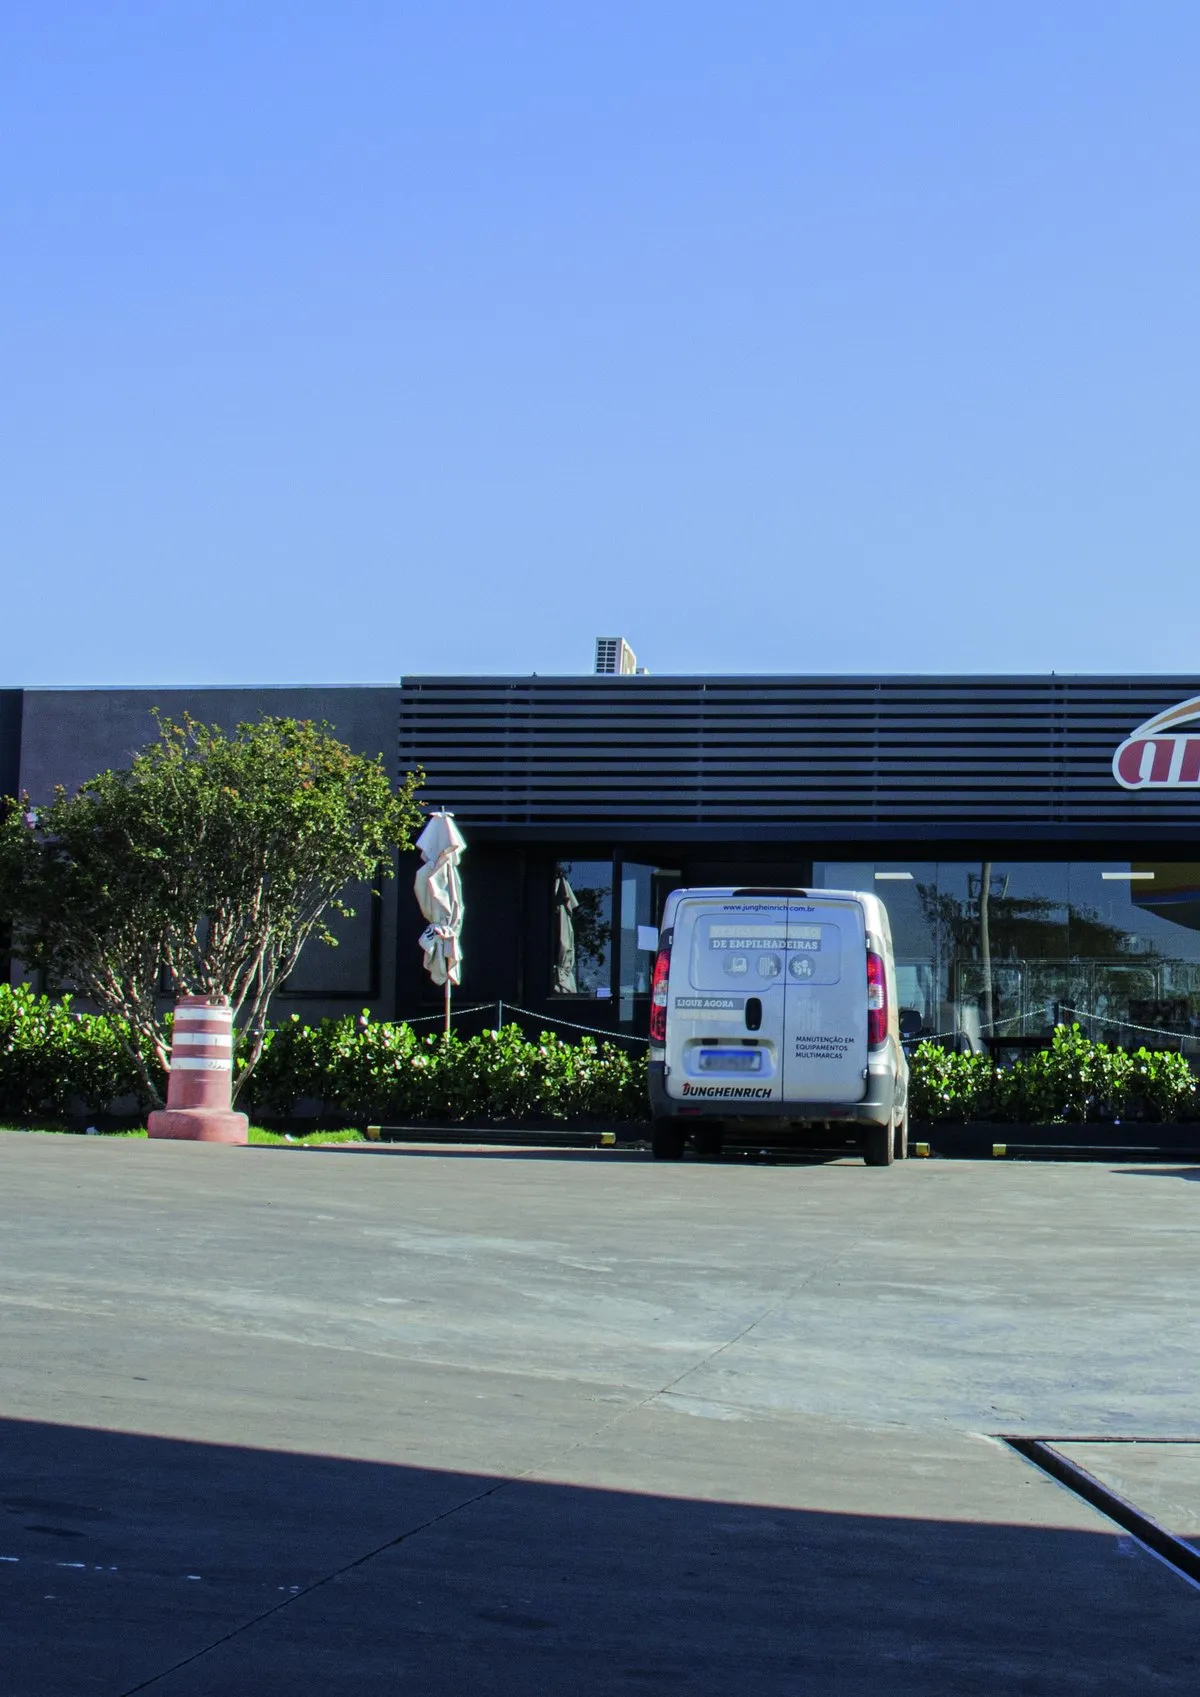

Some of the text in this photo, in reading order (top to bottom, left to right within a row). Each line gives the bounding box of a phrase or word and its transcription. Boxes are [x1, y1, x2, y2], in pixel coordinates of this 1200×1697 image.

[713, 939, 818, 950] DE EMPILHADEIRAS
[677, 999, 734, 1008] LIGUE AGORA
[796, 1036, 844, 1044] MANUTENÇÃO
[682, 1082, 772, 1098] JUNGHEINRICH
